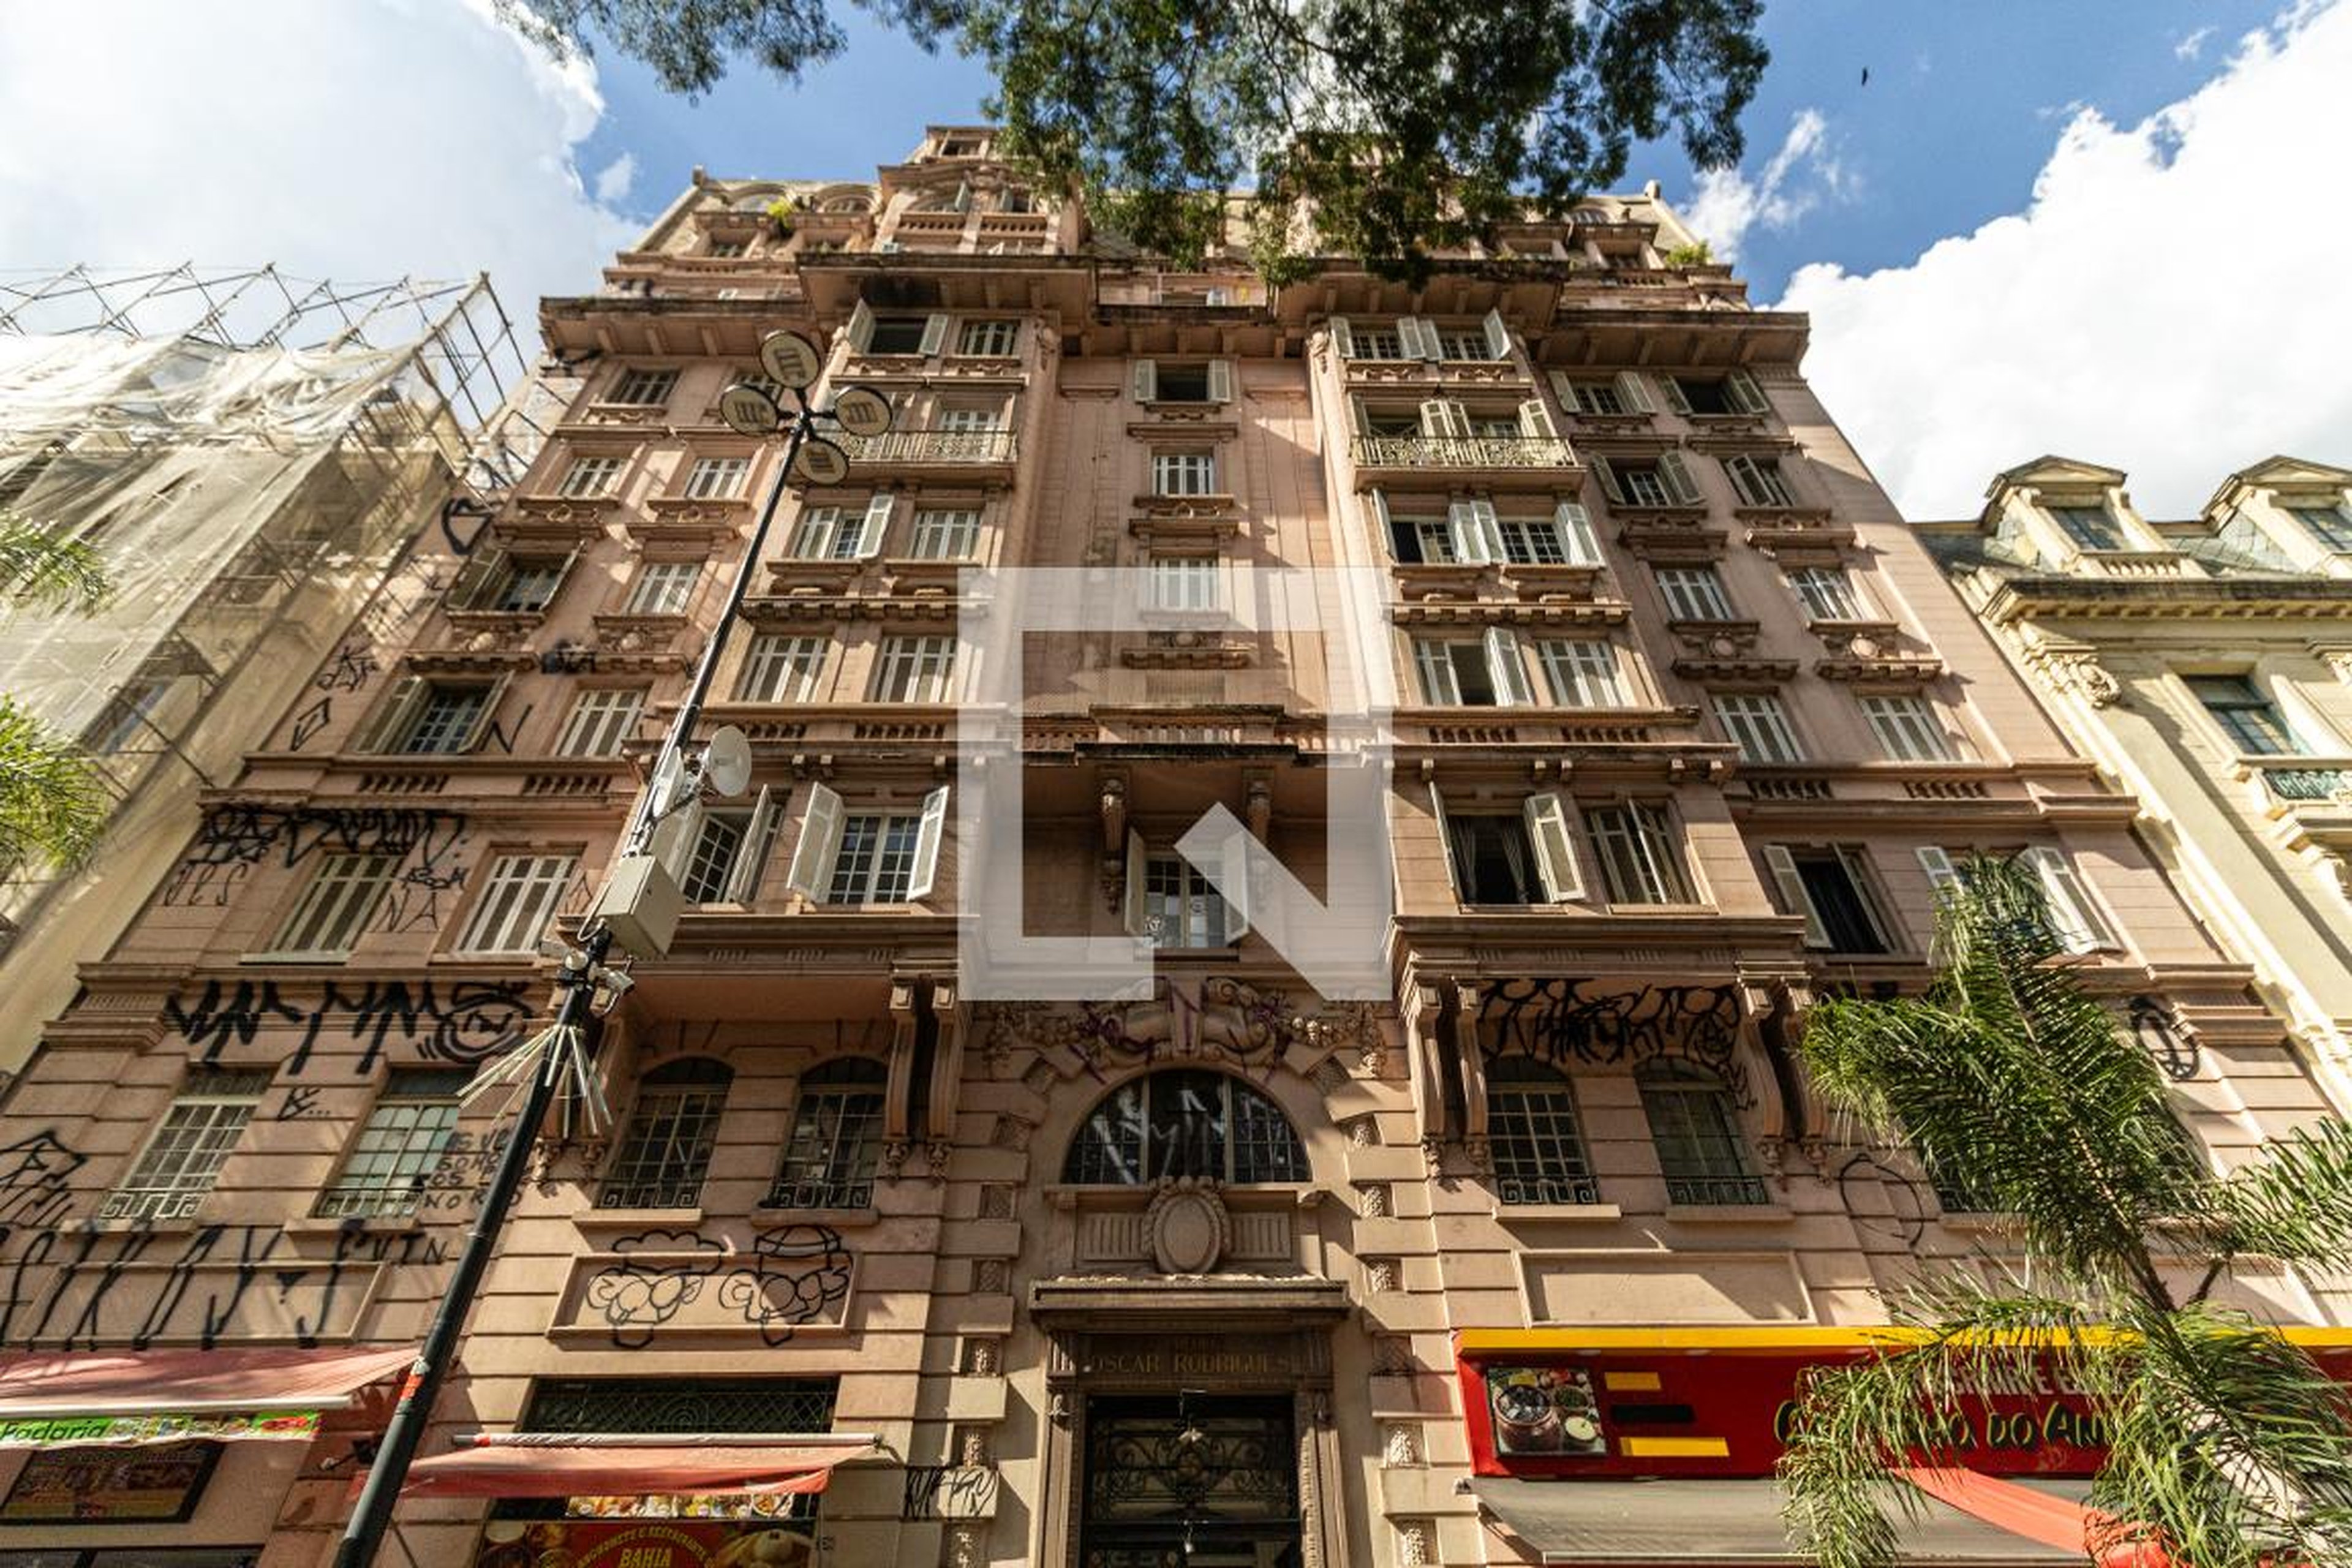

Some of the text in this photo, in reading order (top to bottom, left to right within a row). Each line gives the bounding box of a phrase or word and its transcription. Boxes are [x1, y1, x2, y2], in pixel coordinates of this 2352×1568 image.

[1091, 1354, 1160, 1373] OSCAR
[1986, 1412, 2037, 1448] DO
[619, 1546, 673, 1568] BAHIA
